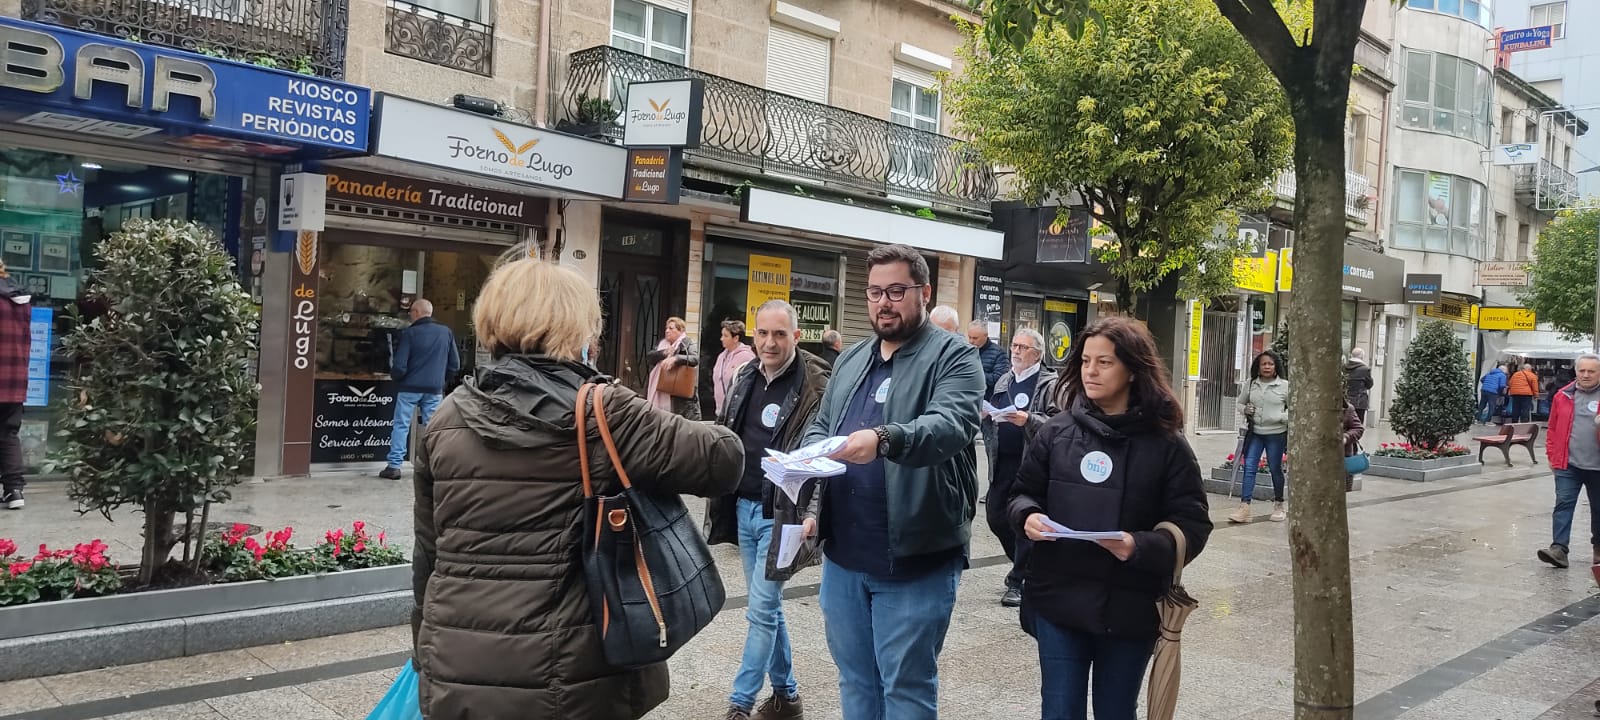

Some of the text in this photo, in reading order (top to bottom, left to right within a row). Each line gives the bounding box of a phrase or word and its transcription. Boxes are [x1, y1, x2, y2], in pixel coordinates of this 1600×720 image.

[1502, 31, 1525, 42] Centro
[1533, 28, 1550, 38] Yoga
[0, 25, 217, 120] BAR
[288, 79, 358, 106] KIOSCO
[268, 96, 357, 126] REVISTAS
[631, 109, 656, 123] Forno
[664, 108, 686, 123] Lugo
[241, 113, 356, 146] PERIÓDICOS
[447, 135, 573, 180] Forno de Lugo
[635, 155, 664, 165] Panadería
[632, 168, 666, 178] Tradicional
[642, 180, 660, 194] Lugo
[327, 174, 524, 218] Panadería Tradicional
[979, 275, 1002, 283] COMPRA
[295, 282, 315, 298] de
[802, 305, 830, 321] ALQUILA
[293, 299, 315, 370] Lugo
[327, 392, 359, 404] Forno
[368, 393, 393, 405] Lugo
[314, 414, 349, 428] Somos
[320, 435, 361, 448] Servicio
[1087, 459, 1107, 476] bng
